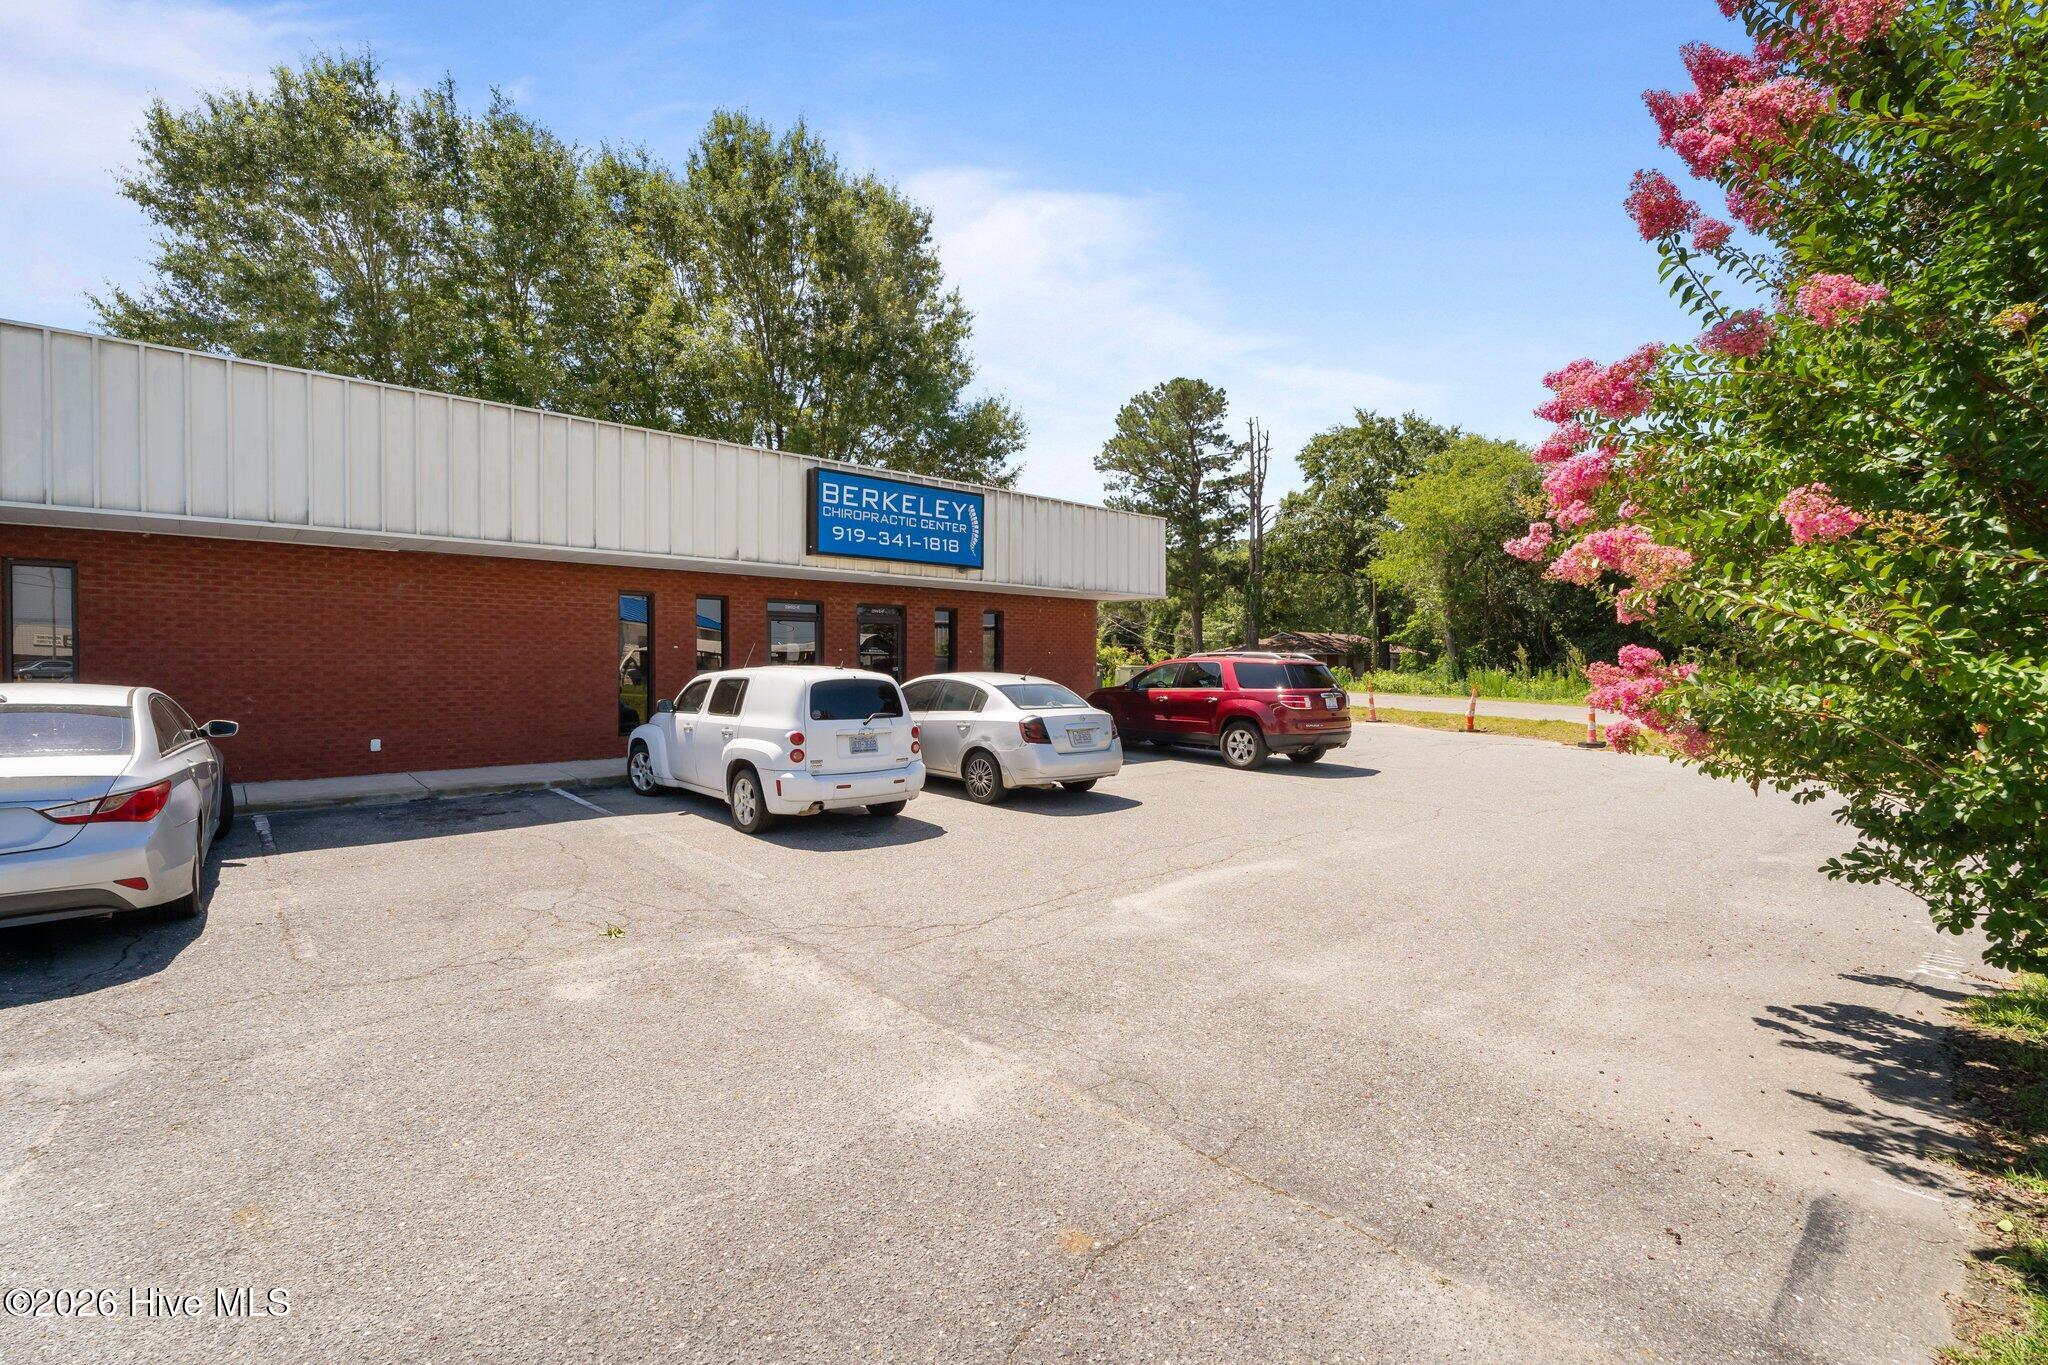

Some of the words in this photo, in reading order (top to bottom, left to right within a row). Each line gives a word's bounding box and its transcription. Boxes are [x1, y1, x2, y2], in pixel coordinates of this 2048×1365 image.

[822, 482, 967, 521] BERKELEY
[822, 505, 917, 528] CHIROPRACTIC
[920, 518, 967, 534] CENTER
[832, 526, 960, 553] 919-341-1818
